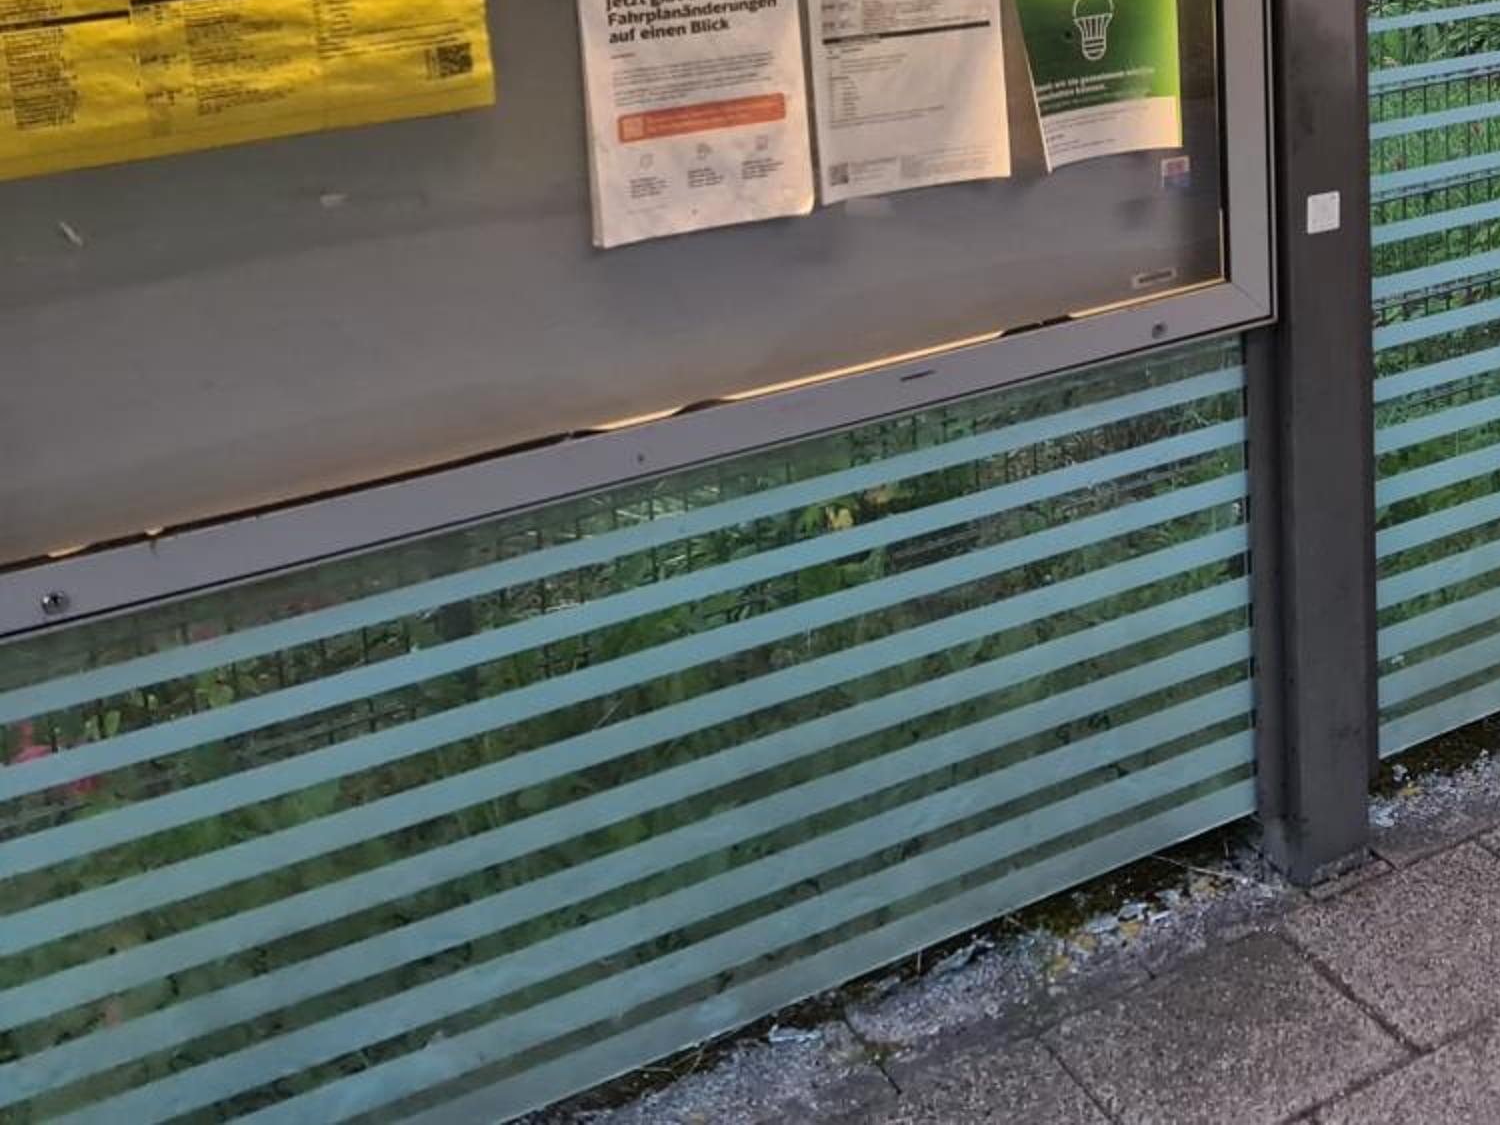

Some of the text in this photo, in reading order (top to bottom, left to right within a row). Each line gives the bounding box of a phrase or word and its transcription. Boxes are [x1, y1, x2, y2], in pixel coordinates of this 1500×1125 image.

[608, 18, 731, 44] auf einen Blick
